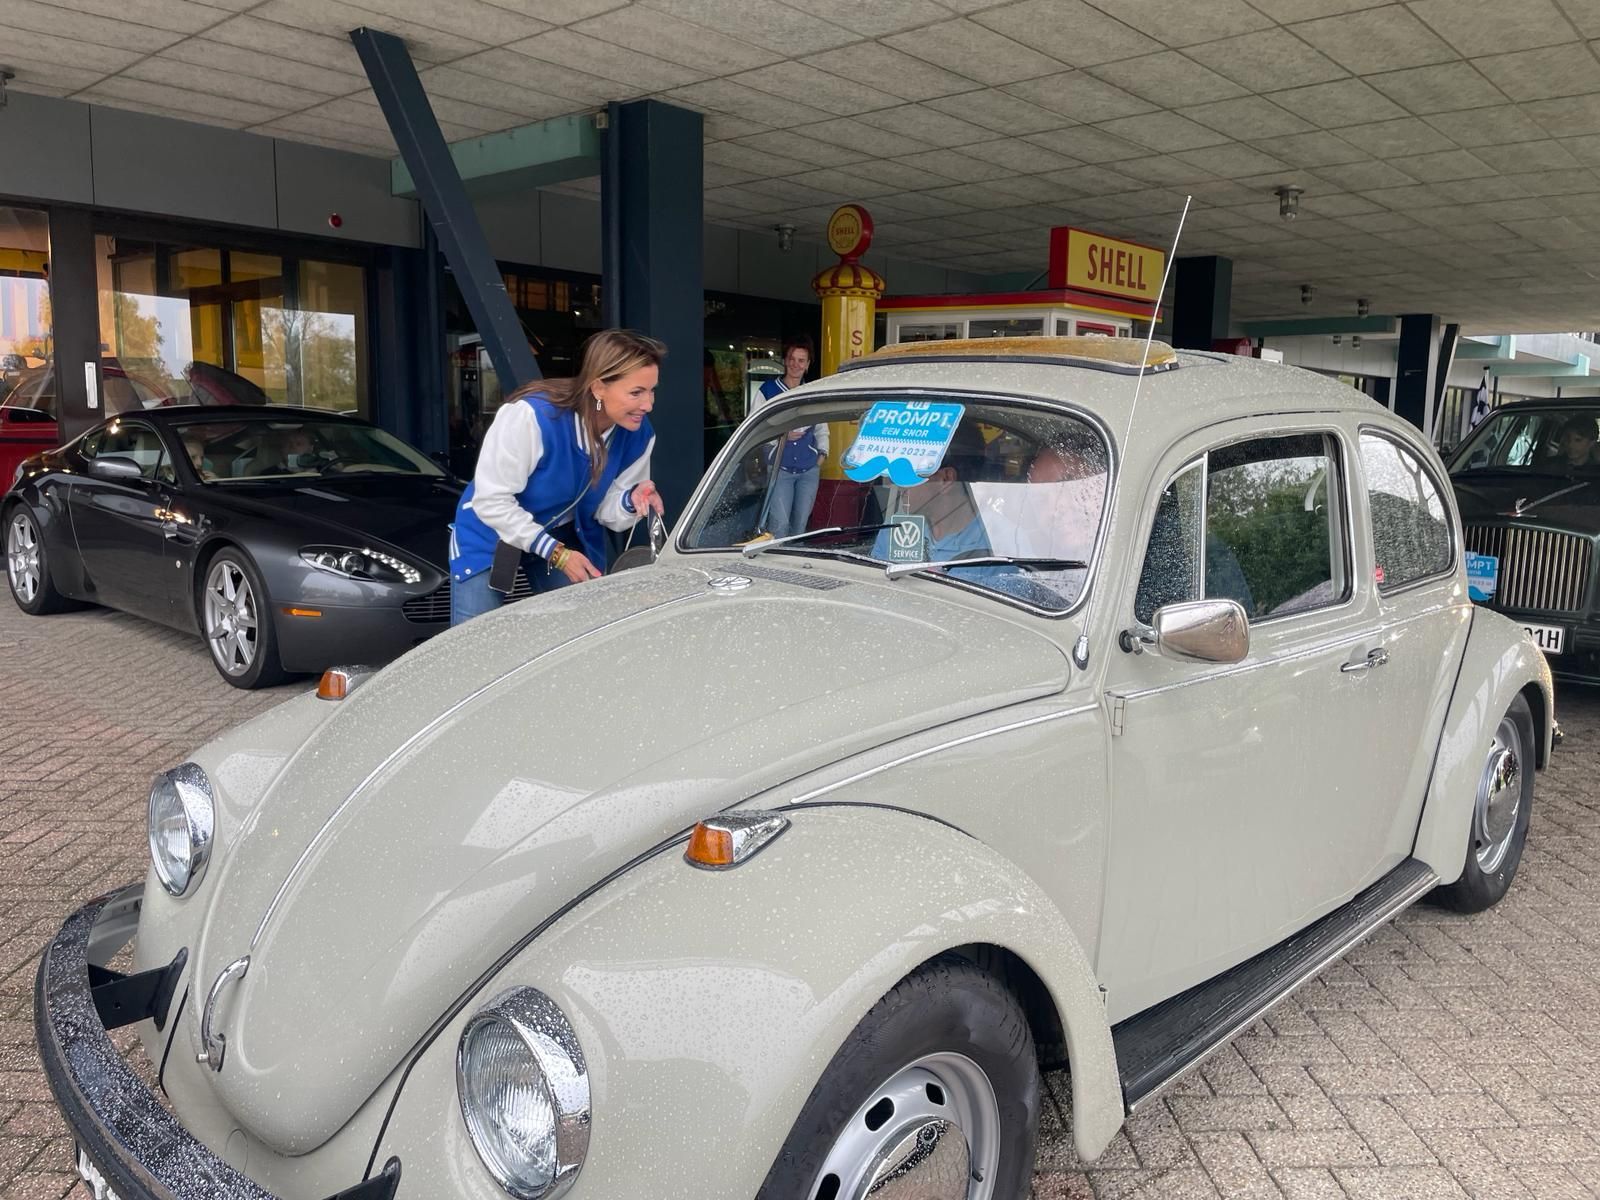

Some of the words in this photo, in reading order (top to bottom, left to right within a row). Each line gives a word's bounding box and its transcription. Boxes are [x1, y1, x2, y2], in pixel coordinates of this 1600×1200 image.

[1087, 243, 1147, 290] SHELL
[872, 409, 954, 428] PROMPT
[881, 427, 900, 436] EEN
[902, 428, 929, 438] SNOR
[866, 443, 898, 454] RALLY
[900, 447, 926, 457] 2023
[893, 549, 919, 558] SERVICE
